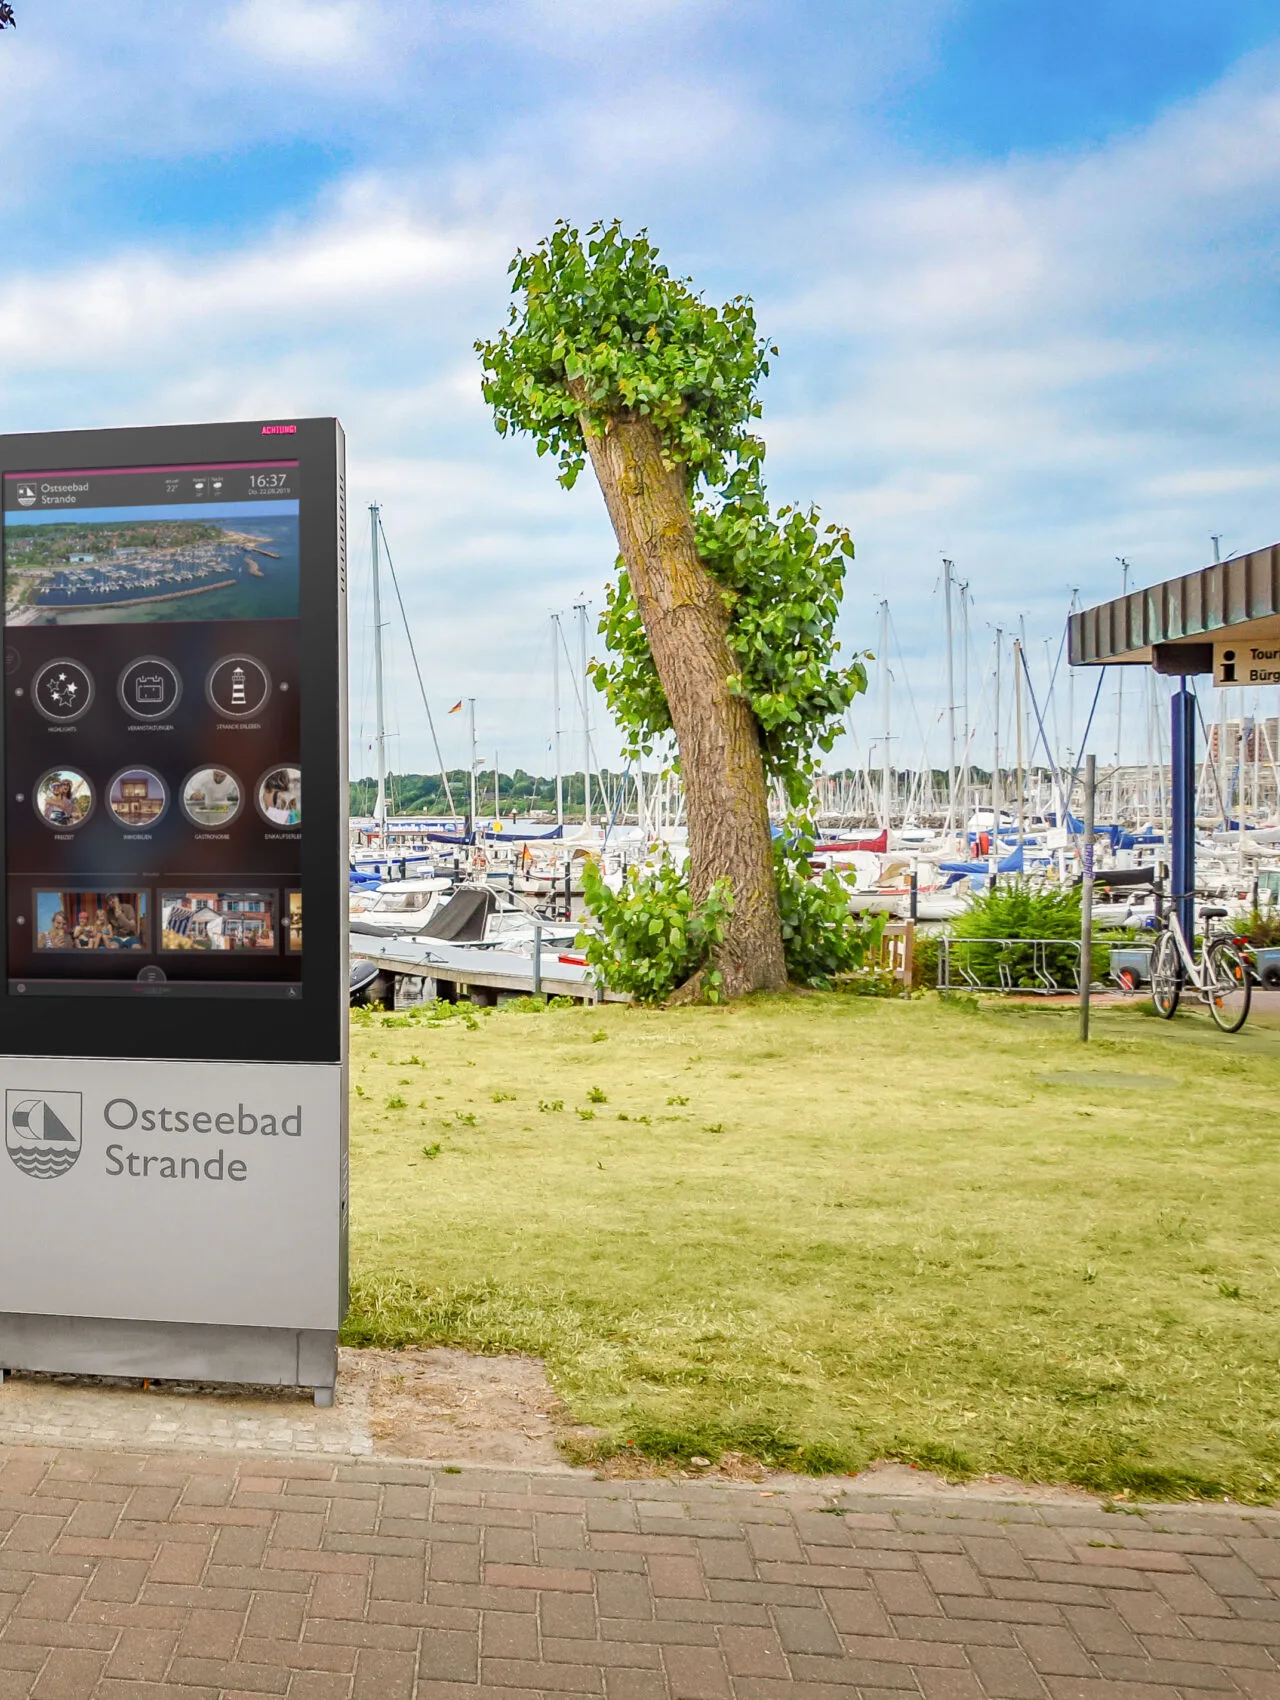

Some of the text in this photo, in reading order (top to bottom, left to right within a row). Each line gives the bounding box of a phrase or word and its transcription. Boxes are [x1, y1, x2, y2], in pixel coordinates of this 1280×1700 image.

[249, 473, 287, 488] 16:37
[40, 482, 89, 493] Ostseebad
[41, 494, 77, 504] Strande
[1250, 648, 1280, 660] Tour
[103, 1098, 302, 1137] Ostseebad
[105, 1144, 247, 1182] Strande
